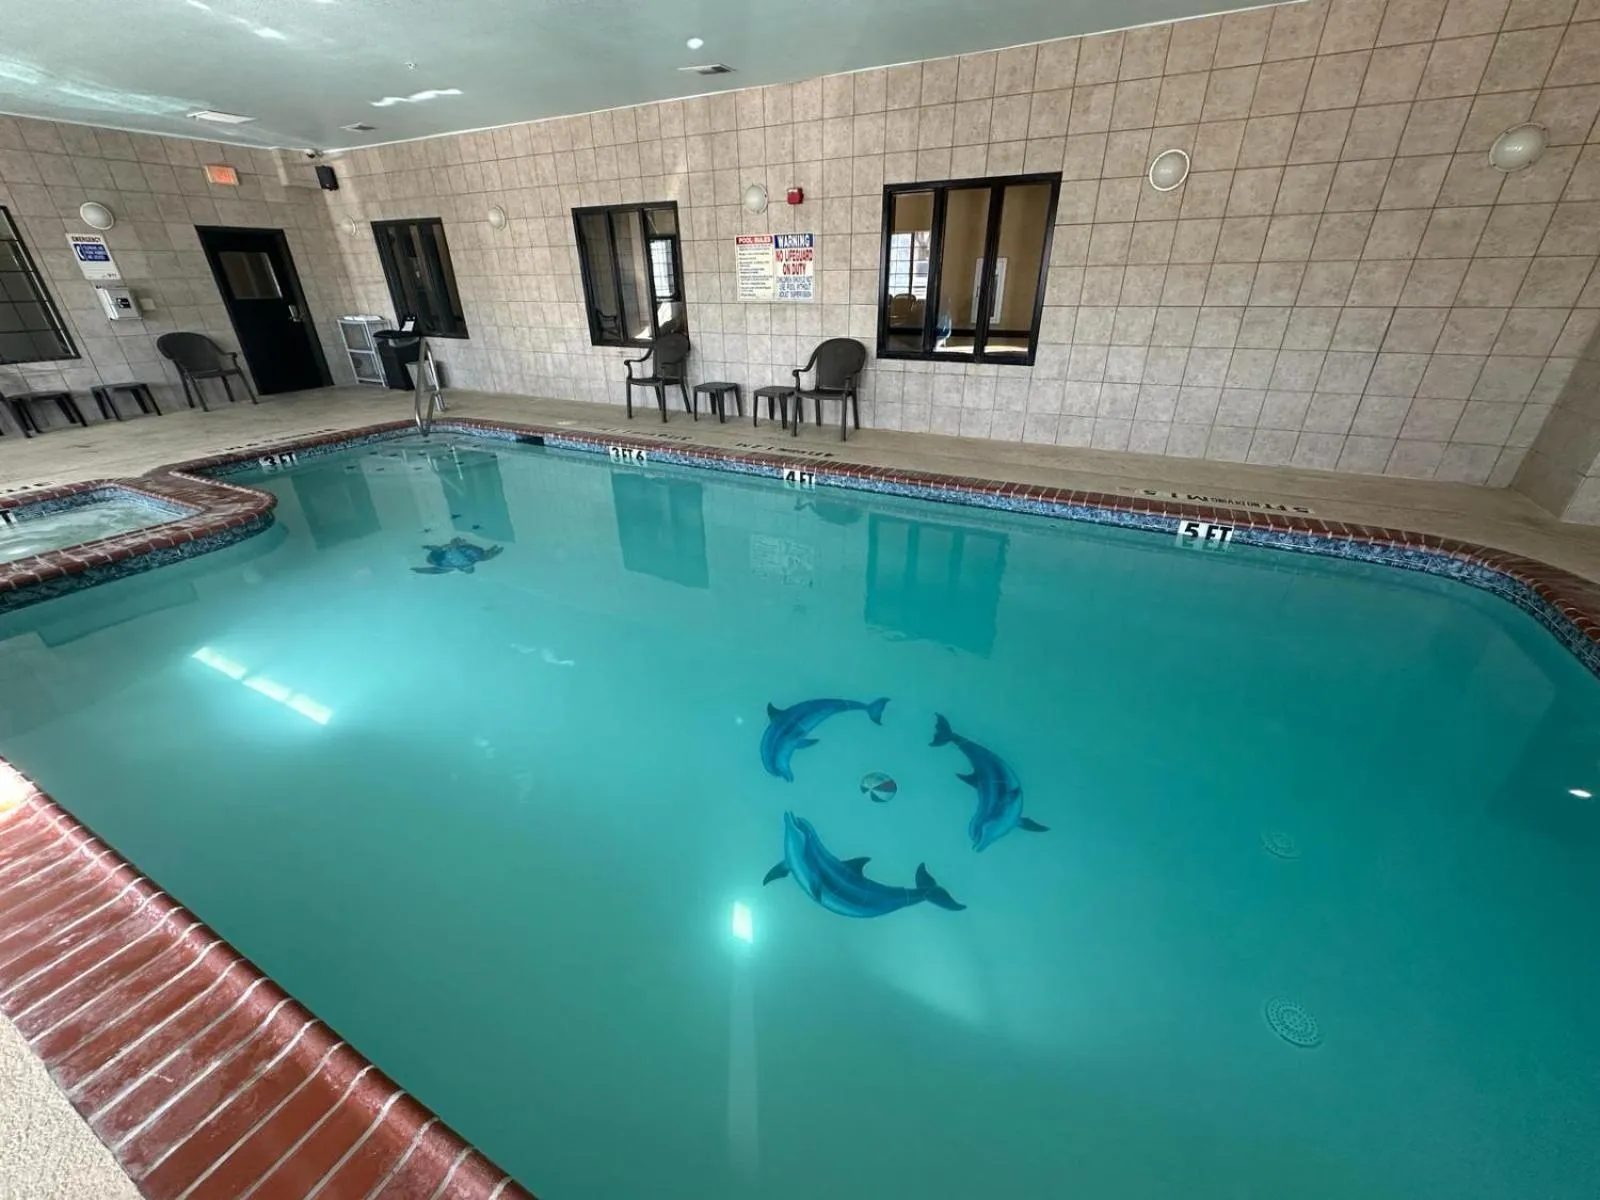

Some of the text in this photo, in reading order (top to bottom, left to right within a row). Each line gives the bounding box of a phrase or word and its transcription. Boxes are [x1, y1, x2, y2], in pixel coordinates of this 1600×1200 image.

[777, 234, 811, 248] WARNING
[776, 249, 812, 262] NO LIFEGUARD
[783, 262, 806, 275] ON DUTY
[264, 452, 296, 466] 3 FT
[622, 448, 633, 459] FT
[636, 450, 645, 461] 6
[786, 471, 814, 484] 4 FT
[1184, 522, 1233, 542] 5 FT
